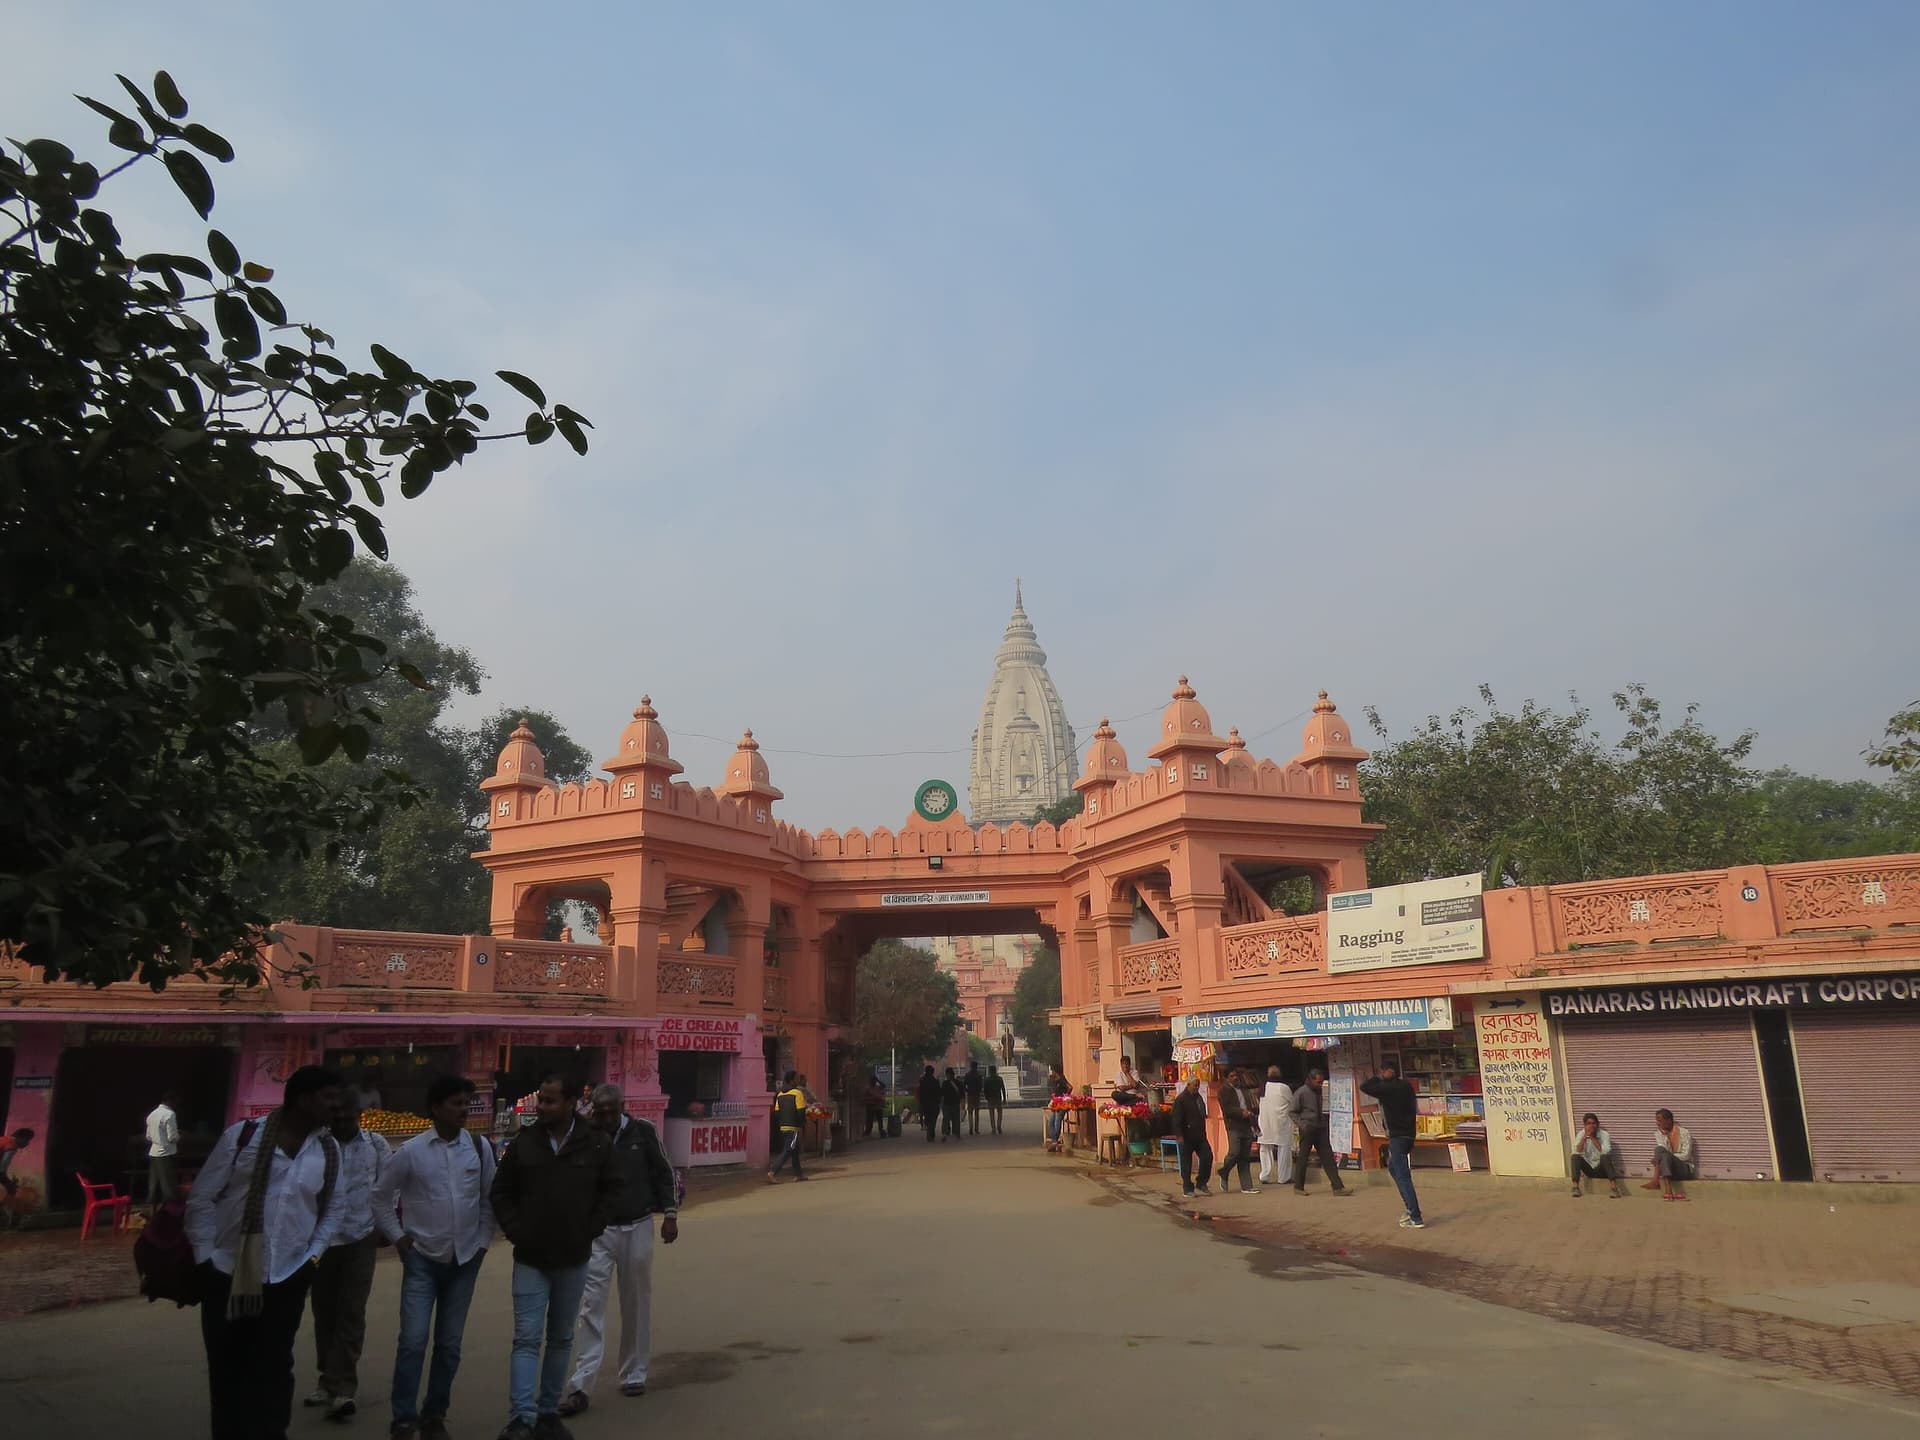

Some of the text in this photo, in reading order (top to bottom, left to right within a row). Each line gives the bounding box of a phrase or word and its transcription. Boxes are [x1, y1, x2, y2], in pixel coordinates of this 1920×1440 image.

[1743, 888, 1757, 900] 18
[1338, 929, 1405, 949] Ragging
[479, 954, 486, 964] 8
[1549, 990, 1655, 1015] BANARAS
[1659, 982, 1811, 1010] HANDICRAFT
[1304, 998, 1424, 1020] GEETA PUSTAKALYA
[661, 1018, 739, 1033] ICE CREAM
[1187, 1012, 1270, 1029] गीता पुस्तकालय
[1316, 1018, 1410, 1031] All Books Available Here
[657, 1034, 691, 1049] COLD
[693, 1035, 738, 1050] COFFEE
[690, 1125, 748, 1154] ICE CREAM
